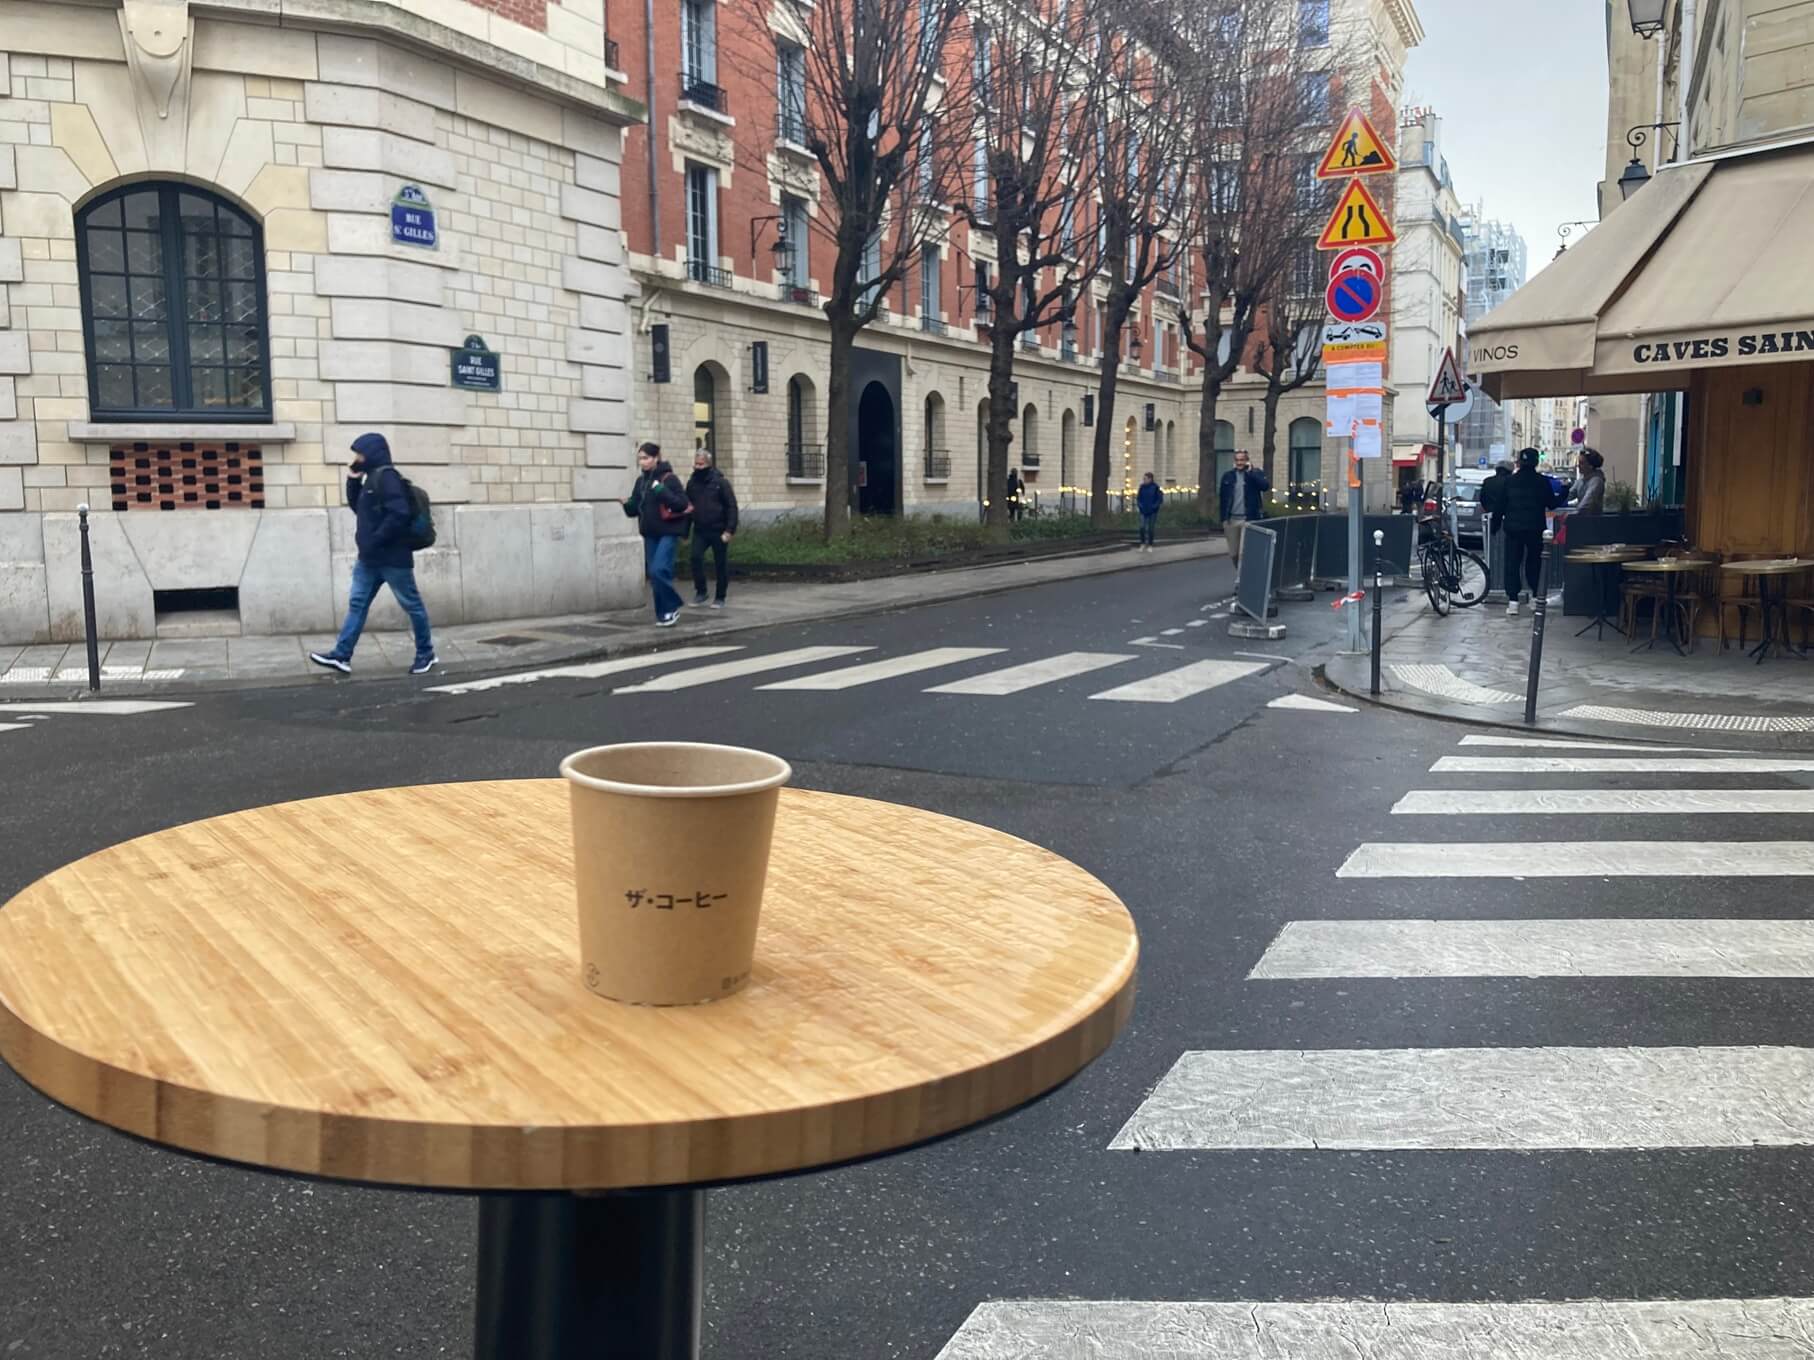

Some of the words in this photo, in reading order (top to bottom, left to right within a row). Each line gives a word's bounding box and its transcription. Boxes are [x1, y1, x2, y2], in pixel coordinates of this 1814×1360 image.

[405, 212, 422, 226] RUE
[403, 226, 434, 241] GILLES
[1473, 345, 1519, 362] VINOS
[1633, 337, 1729, 363] CAVES
[1738, 331, 1814, 356] SAIN
[470, 355, 482, 366] RUE
[624, 888, 728, 910] ザ・コーヒー
